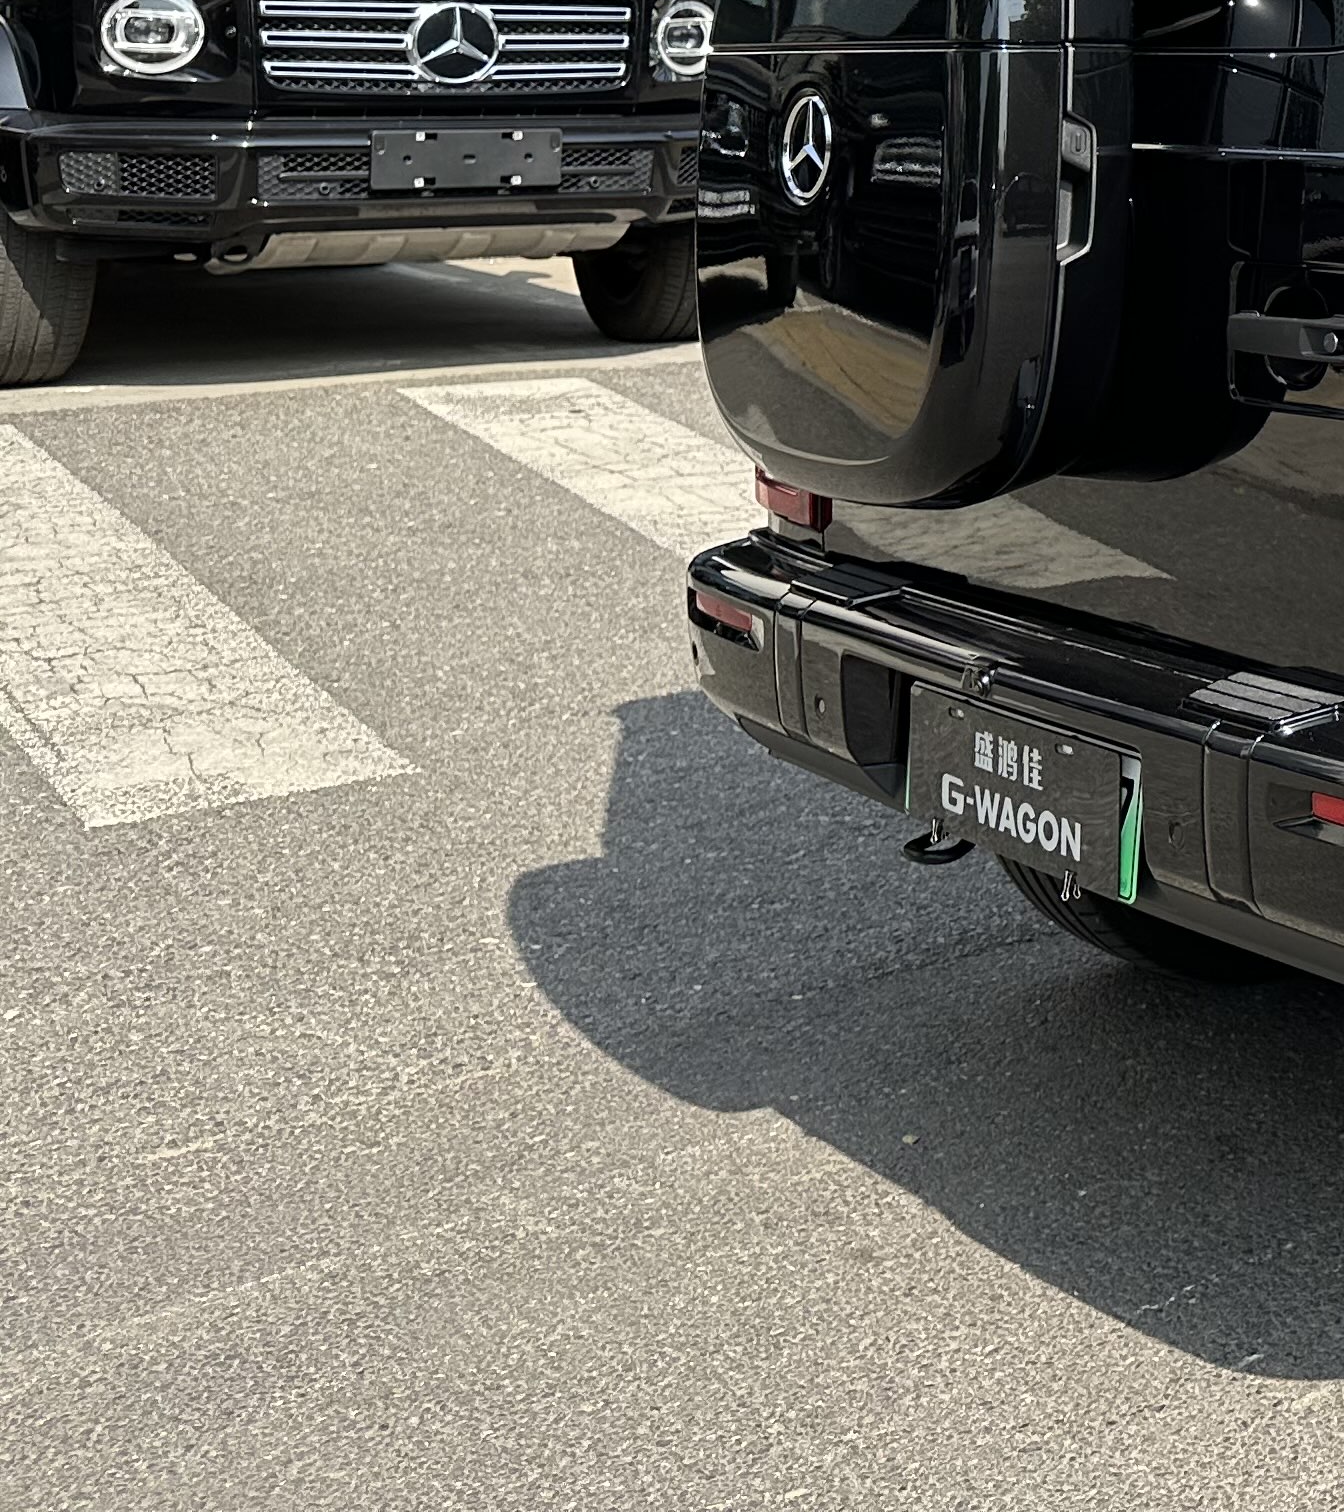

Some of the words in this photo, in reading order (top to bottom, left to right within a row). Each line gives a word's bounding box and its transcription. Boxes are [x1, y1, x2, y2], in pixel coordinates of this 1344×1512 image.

[973, 730, 1044, 791] 盛鸿佳
[941, 773, 1082, 862] G-WAGON
